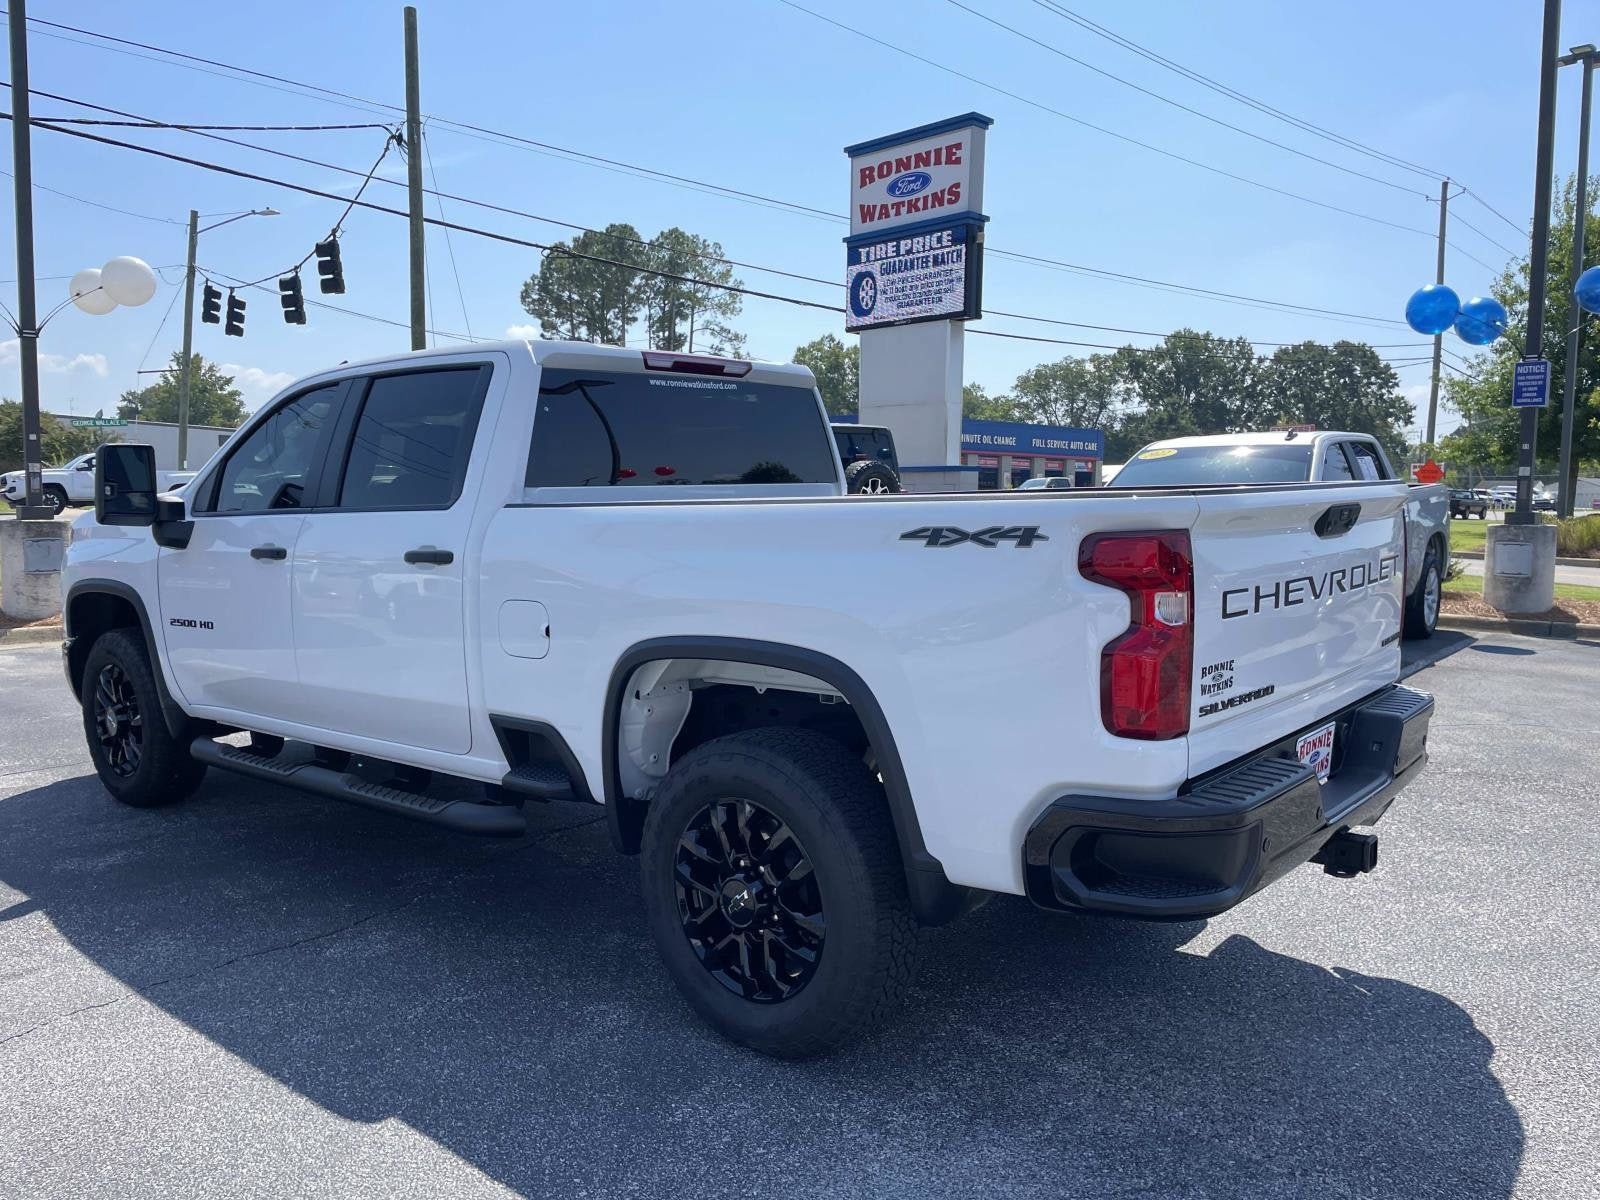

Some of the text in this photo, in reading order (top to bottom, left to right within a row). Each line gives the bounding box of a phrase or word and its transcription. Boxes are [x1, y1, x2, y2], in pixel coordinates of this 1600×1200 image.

[860, 142, 962, 188] RONNIE
[859, 182, 961, 224] WATKINS
[859, 230, 953, 263] TIRE PRICE
[880, 249, 963, 276] GUARANTEE MATCH
[1517, 365, 1545, 373] NOTICE
[650, 379, 737, 391] www.ronniewatkinsford.com
[982, 435, 992, 445] OIL
[993, 436, 1016, 446] CHANGE
[1032, 438, 1098, 451] FULL SERVICE AUTO CARE
[1221, 555, 1399, 620] CHEVROLET
[170, 618, 214, 630] 2500 HD
[1201, 659, 1235, 680] RONNIE
[1200, 676, 1234, 697] WATKINS
[1199, 685, 1275, 718] SILVERADO
[1299, 730, 1332, 760] RONNIE
